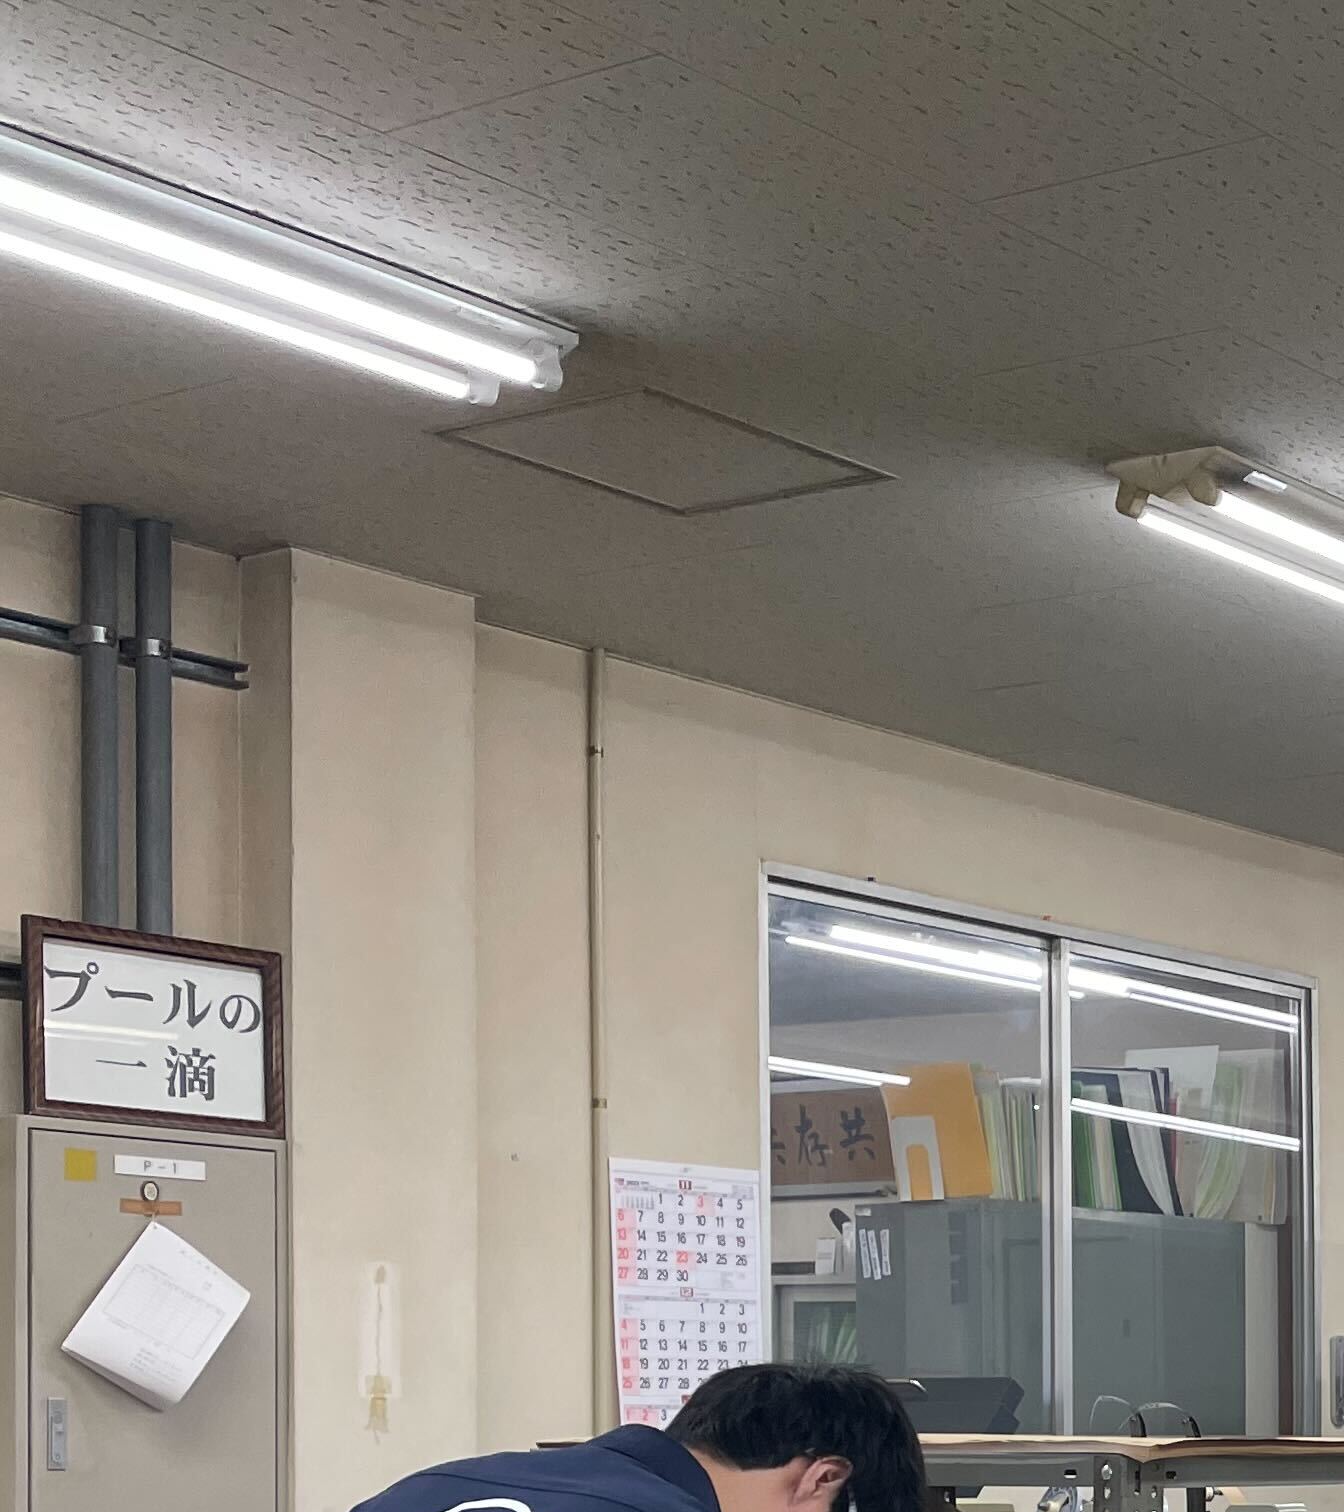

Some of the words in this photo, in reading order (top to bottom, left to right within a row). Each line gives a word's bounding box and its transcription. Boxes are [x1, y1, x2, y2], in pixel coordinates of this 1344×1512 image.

[44, 962, 261, 1034] プールの
[95, 1045, 216, 1101] 一滴
[659, 1193, 662, 1204] 1
[678, 1194, 684, 1206] 2
[698, 1196, 704, 1208] 3
[717, 1198, 723, 1208] 4
[737, 1199, 742, 1210] 5
[638, 1210, 643, 1222] 7
[658, 1212, 664, 1223] 8
[678, 1214, 684, 1225] 9
[696, 1215, 706, 1226] 10
[716, 1217, 724, 1228] 11
[736, 1218, 744, 1229] 12
[637, 1230, 646, 1240] 14
[657, 1231, 666, 1242] 15
[677, 1232, 686, 1244] 16
[696, 1233, 705, 1244] 17
[717, 1235, 725, 1246] 18
[736, 1236, 745, 1248] 19
[637, 1249, 646, 1260] 21
[657, 1250, 668, 1262] 22
[676, 1251, 688, 1263] 23
[696, 1252, 707, 1264] 24
[716, 1254, 727, 1264] 25
[736, 1255, 747, 1266] 26
[637, 1268, 648, 1280] 28
[657, 1269, 668, 1281] 29
[677, 1270, 688, 1281] 30
[700, 1302, 704, 1314] 1
[720, 1304, 725, 1314] 2
[739, 1304, 744, 1315] 3
[640, 1320, 646, 1331] 5
[659, 1321, 665, 1332] 6
[680, 1321, 685, 1332] 7
[700, 1322, 705, 1332] 8
[720, 1322, 725, 1333] 9
[738, 1323, 747, 1334] 10
[640, 1339, 648, 1350] 12
[659, 1340, 667, 1351] 13
[678, 1340, 687, 1351] 14
[698, 1341, 707, 1352] 15
[718, 1341, 727, 1352] 16
[738, 1341, 746, 1352] 17
[640, 1358, 648, 1369] 19
[658, 1359, 669, 1370] 20
[678, 1359, 688, 1370] 21
[698, 1360, 708, 1370] 22
[640, 1378, 650, 1388] 26
[659, 1378, 669, 1389] 27
[678, 1378, 689, 1389] 28
[661, 1409, 666, 1420] 3
